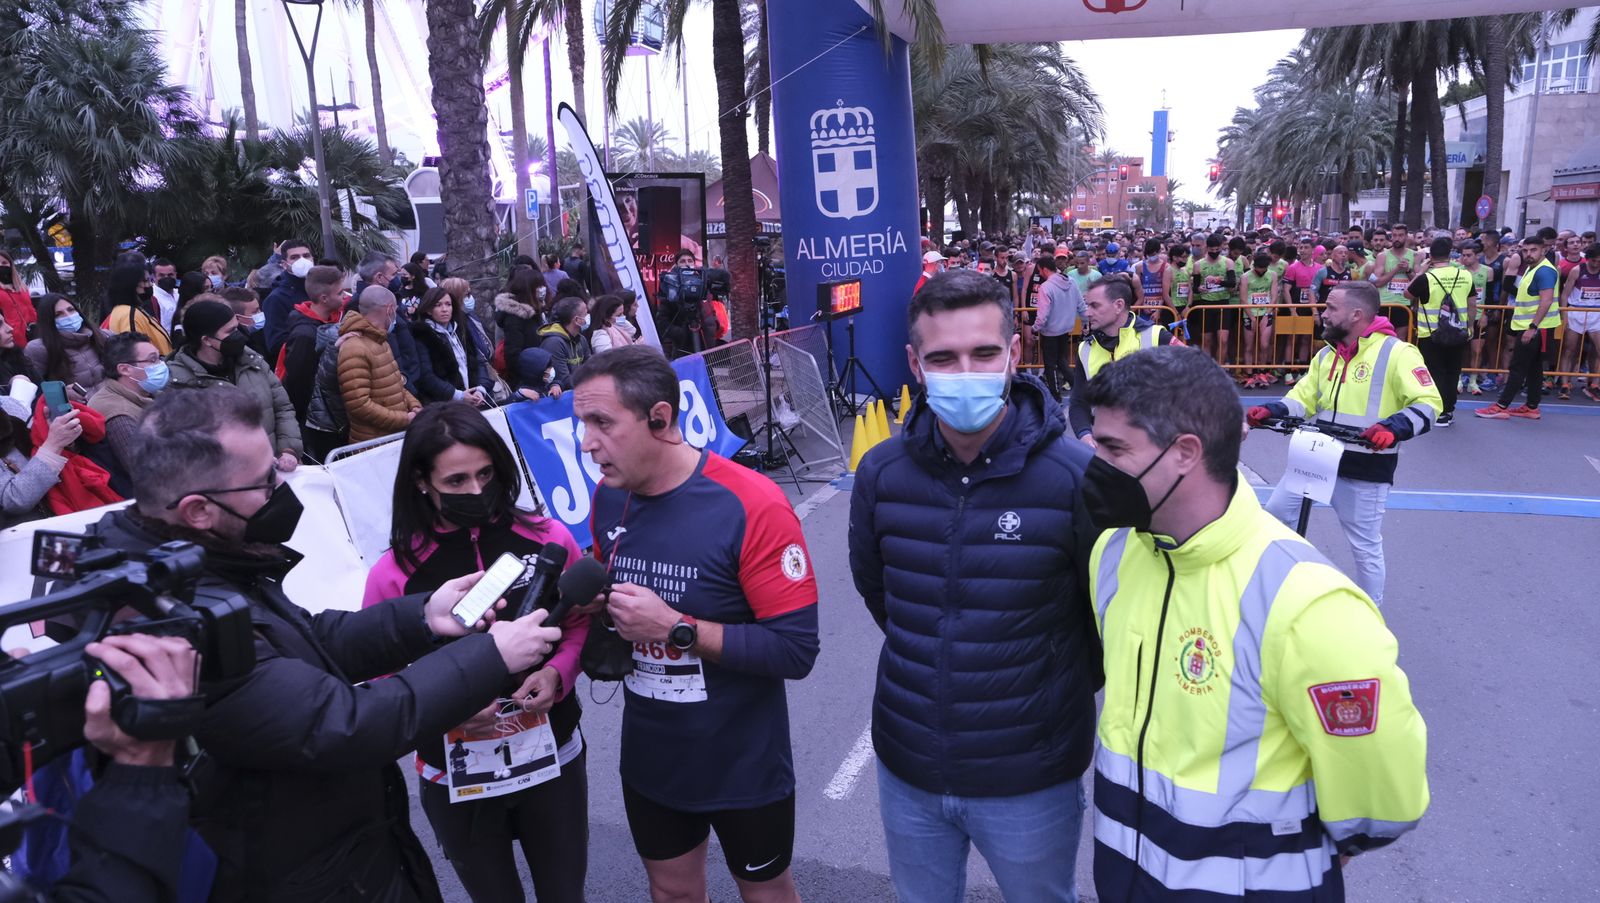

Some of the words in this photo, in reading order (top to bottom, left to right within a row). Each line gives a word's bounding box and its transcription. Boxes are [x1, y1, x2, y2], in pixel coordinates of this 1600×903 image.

[528, 190, 536, 208] P
[797, 226, 907, 260] ALMERÍA
[821, 259, 884, 277] CIUDAD
[1294, 467, 1328, 483] FEMENINA
[614, 555, 646, 572] CARRERA
[652, 561, 698, 580] BOMBEROS
[654, 576, 686, 592] CIUDAD
[1179, 627, 1222, 657] BOMBEROS
[637, 662, 666, 675] FRANCISCO
[1175, 673, 1214, 696] ALMERIA
